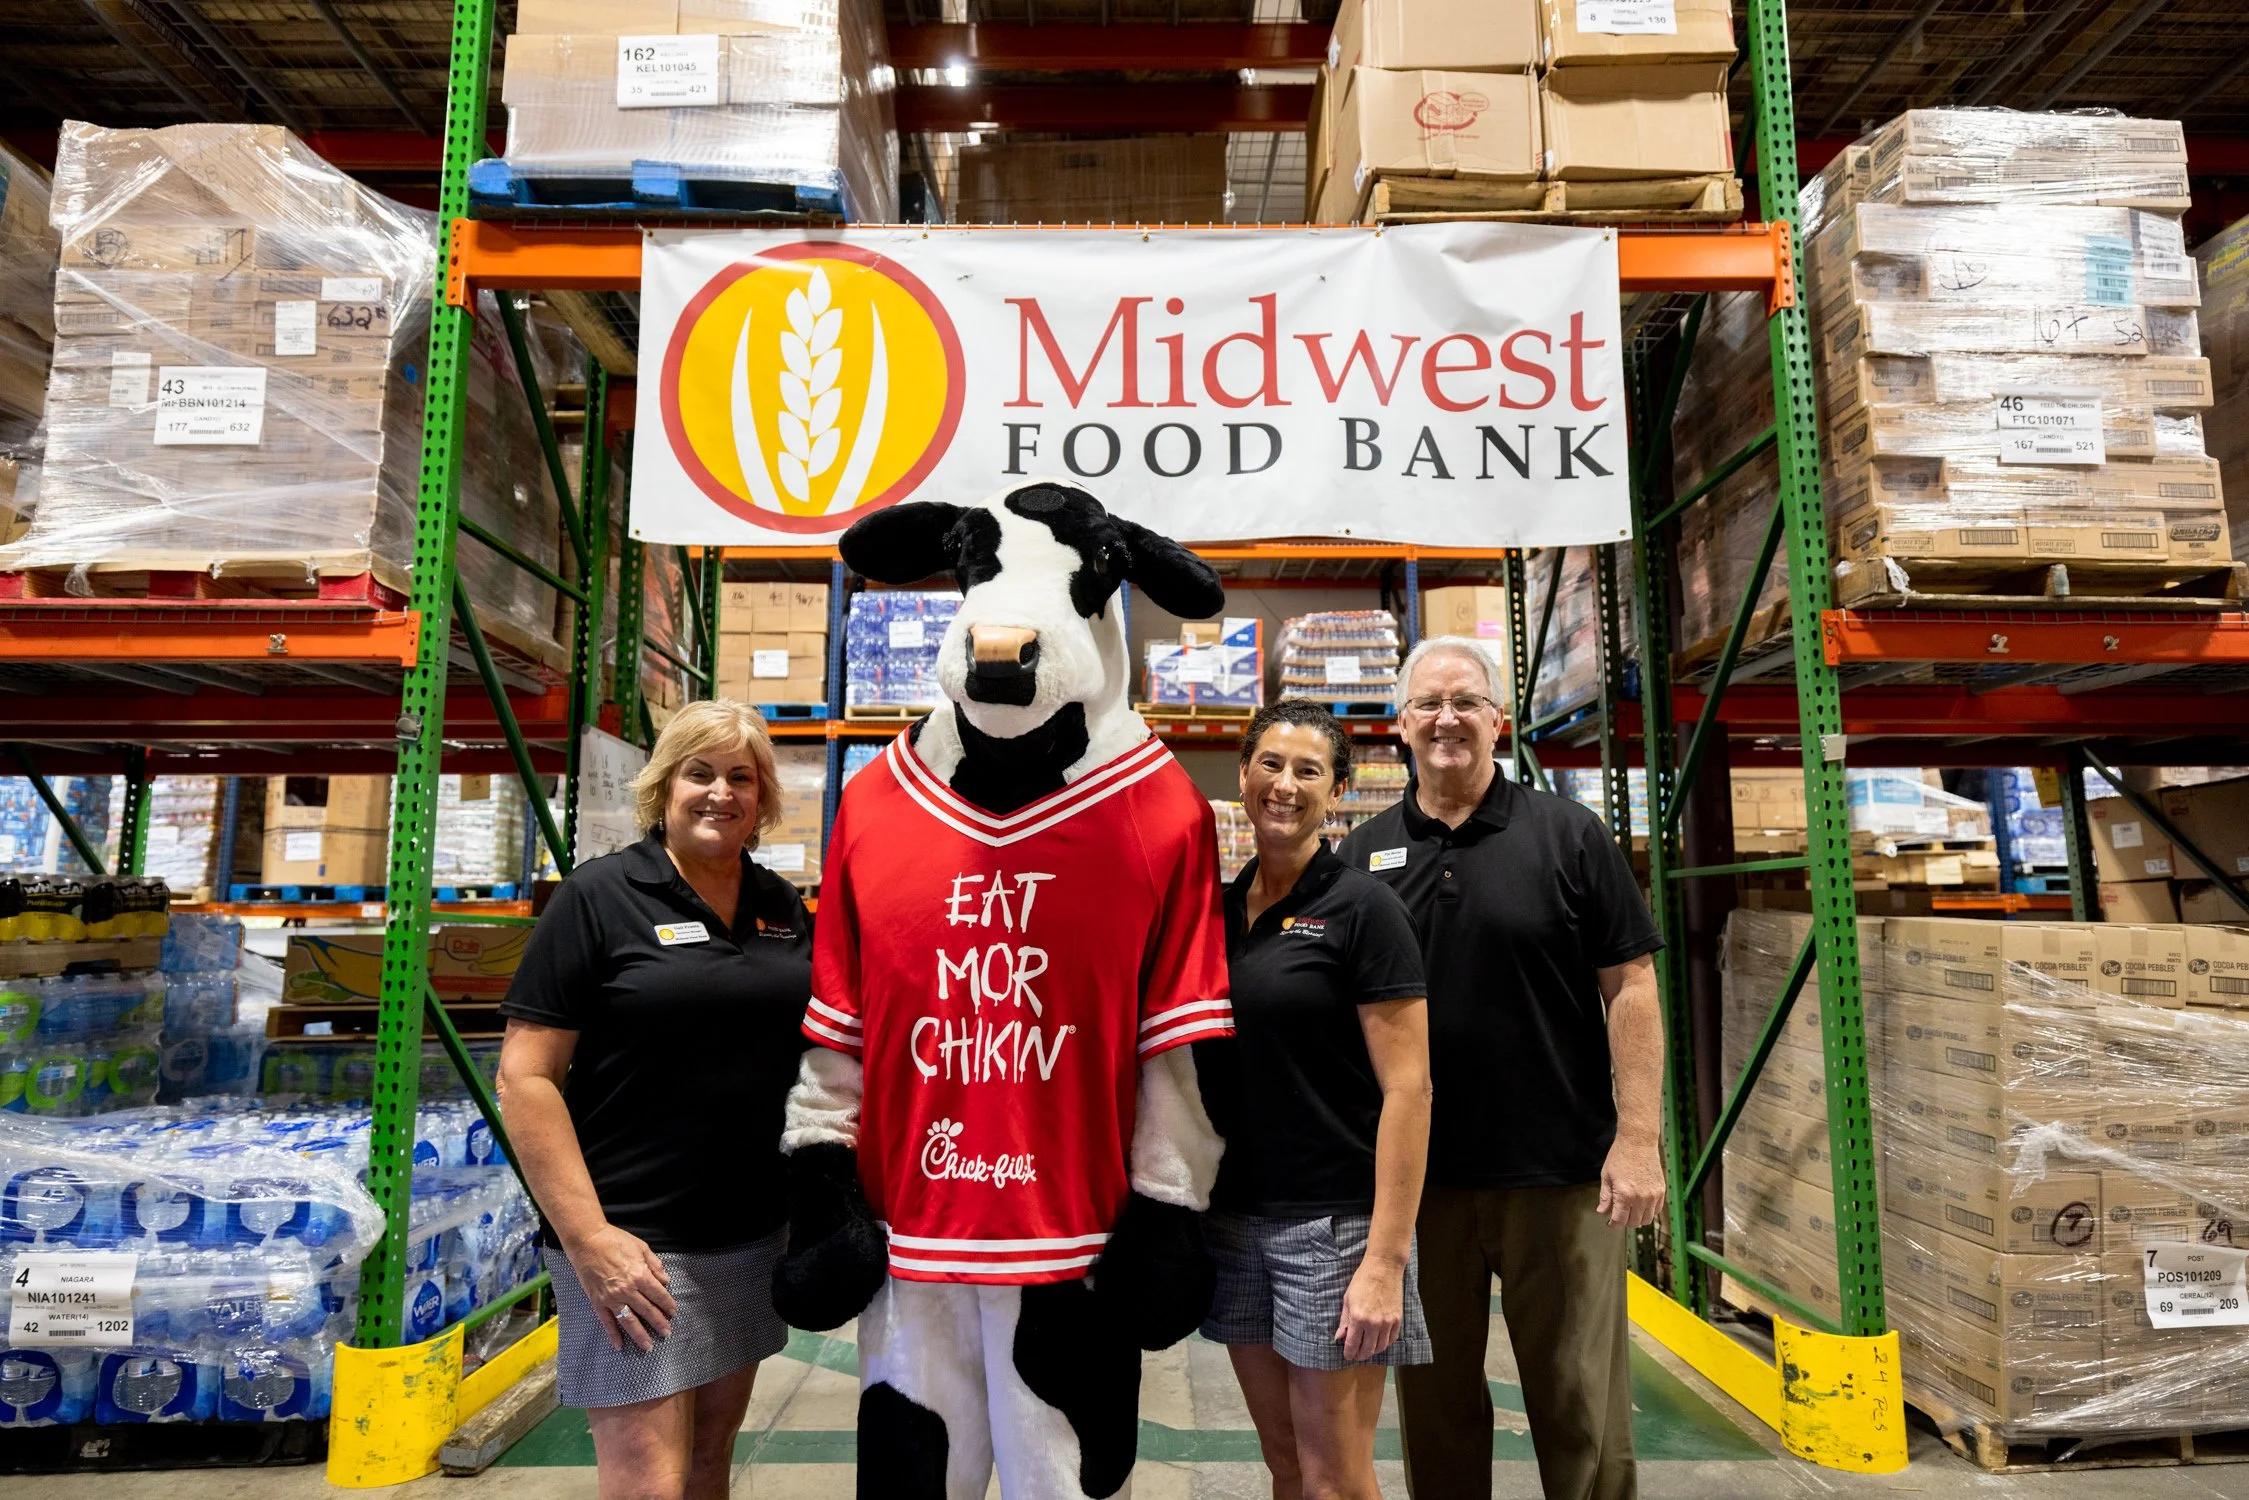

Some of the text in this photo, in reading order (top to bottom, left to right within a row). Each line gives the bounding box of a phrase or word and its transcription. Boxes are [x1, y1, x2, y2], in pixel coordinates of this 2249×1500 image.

[1590, 13, 1597, 21] 8
[1648, 16, 1667, 24] 130
[623, 47, 656, 62] 162
[636, 62, 698, 73] KEL101045
[688, 85, 708, 93] 421
[1003, 292, 1608, 412] Midwest
[162, 379, 185, 395] 43
[2000, 395, 2025, 412] 46
[2013, 415, 2076, 425] FTC101071
[168, 422, 188, 432] 177
[229, 422, 250, 432] 632
[1001, 416, 1615, 481] FOOD BANK
[2014, 440, 2034, 450] 167
[2076, 441, 2095, 451] 521
[944, 869, 1057, 934] EAT
[2034, 961, 2057, 970] COCOA
[2058, 962, 2087, 971] PEBBLES
[2103, 962, 2176, 975] Post COCOA PEBBLES
[2212, 961, 2236, 970] COCOA
[936, 942, 1049, 1018] MOR
[2131, 1125, 2153, 1134] COCOA
[2154, 1126, 2184, 1135] PEBBLES
[2036, 1207, 2059, 1217] COCOA
[2135, 1207, 2157, 1217] COCOA
[2158, 1208, 2188, 1218] PEBBLES
[2201, 1218, 2233, 1244] 69
[2147, 1250, 2158, 1267] 7
[15, 1267, 30, 1288] 4
[2158, 1270, 2222, 1282] POS101209
[28, 1292, 96, 1304] NIA101241
[2064, 1292, 2093, 1302] PEBBLES
[2160, 1301, 2173, 1312] 69
[2219, 1298, 2239, 1310] 209
[48, 1313, 90, 1321] WATER(14)
[23, 1321, 39, 1333] 42
[97, 1320, 129, 1332] 1202
